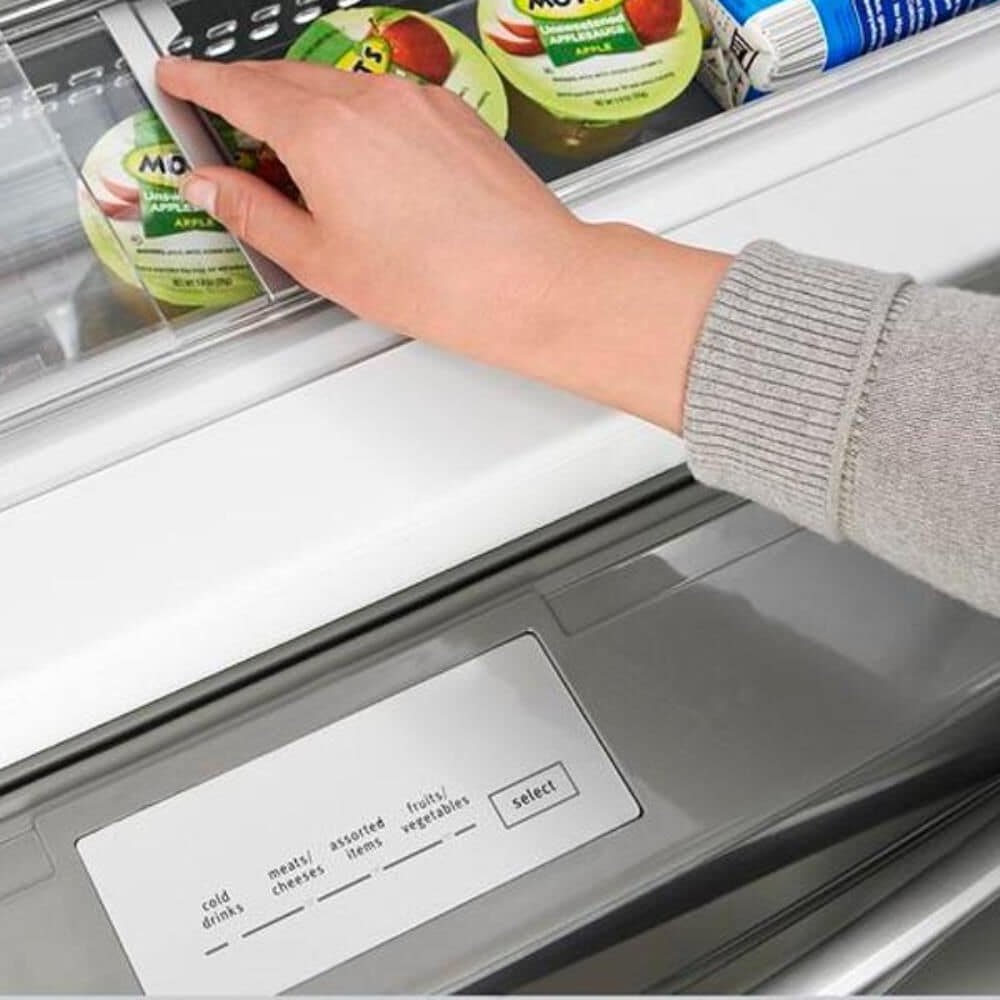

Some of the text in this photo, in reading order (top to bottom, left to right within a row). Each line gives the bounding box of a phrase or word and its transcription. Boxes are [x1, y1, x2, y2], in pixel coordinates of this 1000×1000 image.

[406, 785, 448, 815] fruits/
[511, 779, 558, 810] select
[400, 795, 471, 834] vegetables
[329, 816, 386, 852] assorted
[344, 837, 384, 861] items
[267, 849, 313, 880] meats/
[271, 865, 326, 896] cheeses
[201, 889, 231, 912] cold
[202, 903, 245, 929] drinks
